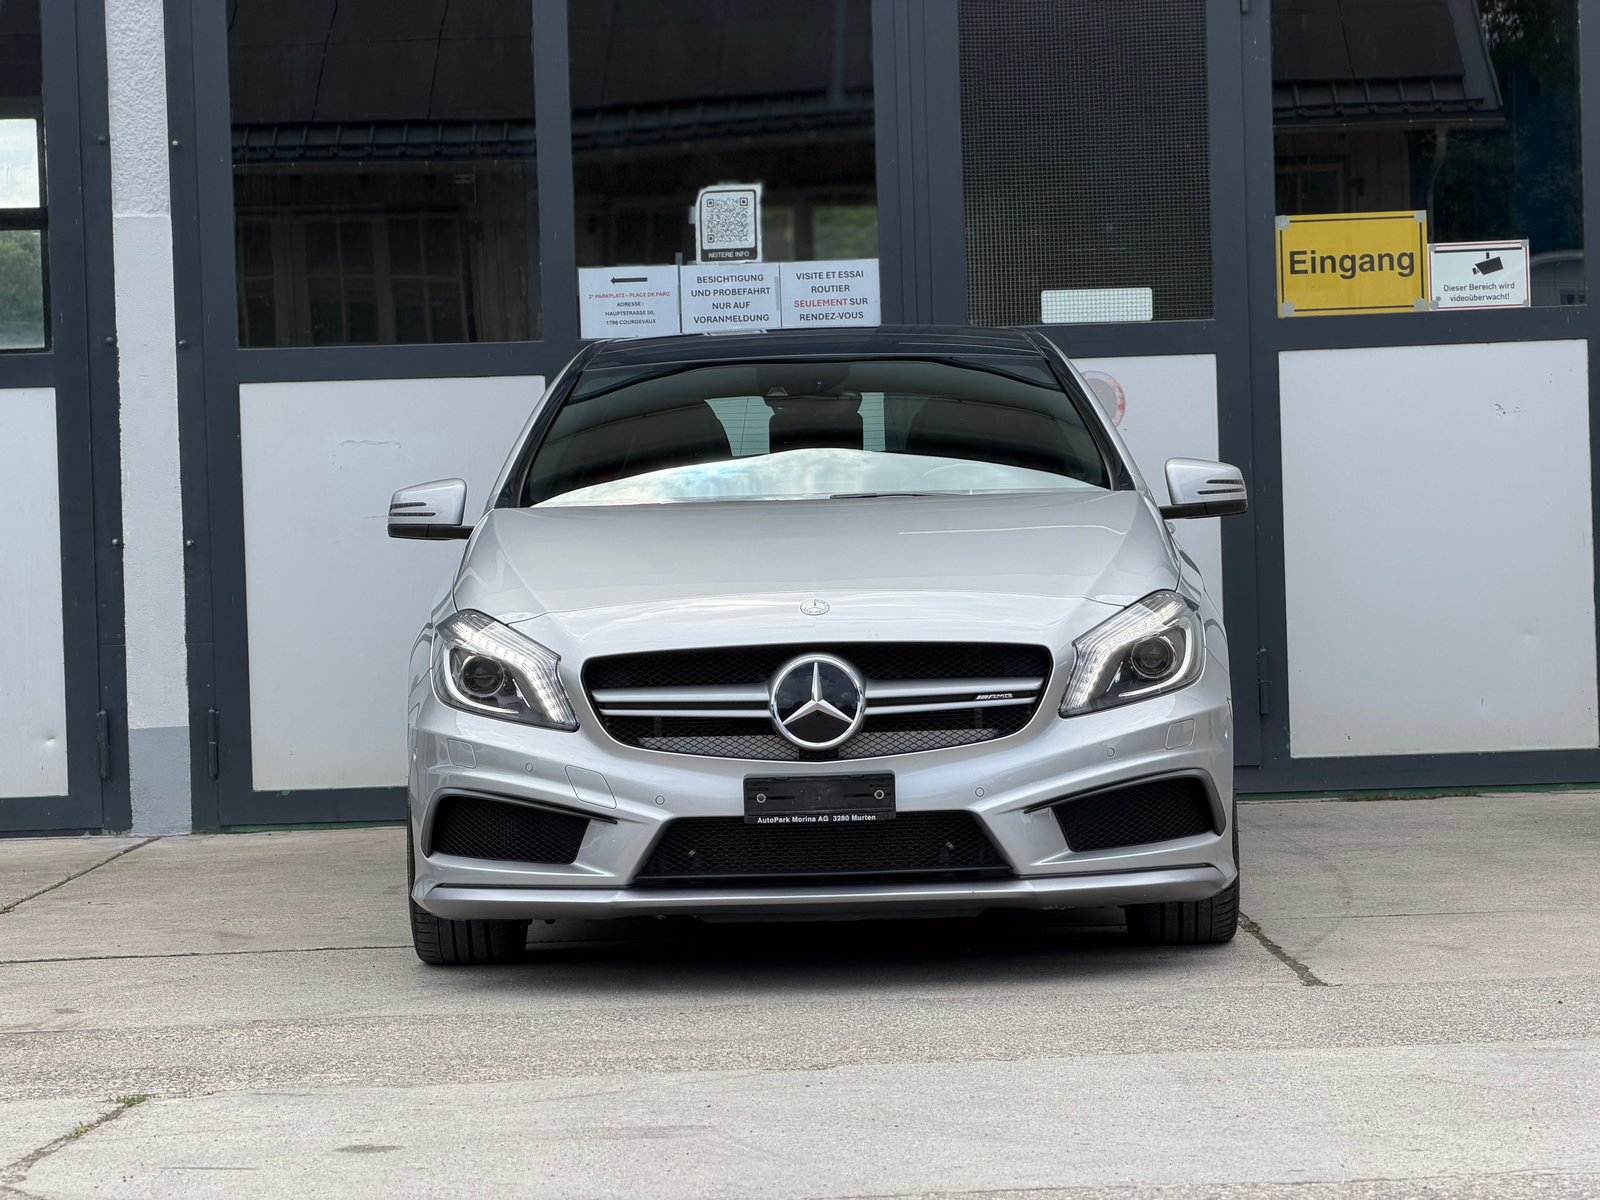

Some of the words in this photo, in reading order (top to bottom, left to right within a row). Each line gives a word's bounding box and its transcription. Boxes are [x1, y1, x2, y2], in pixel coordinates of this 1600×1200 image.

[1289, 250, 1415, 279] Eingang
[696, 274, 764, 284] BESICHTIGUNG
[796, 272, 824, 280] VISITE
[825, 271, 836, 279] ET
[838, 270, 864, 279] ESSAI
[691, 289, 711, 297] UND
[713, 287, 771, 297] PROBEFAHRT
[811, 284, 850, 293] ROUTIER
[1443, 284, 1468, 292] Dieser
[1469, 282, 1497, 291] Bereich
[1450, 293, 1510, 302] videoüberwacht!
[712, 302, 732, 310] NUR
[733, 301, 751, 309] AUF
[794, 298, 848, 308] SEULEMENT
[694, 314, 770, 324] VORANMELDUNG
[800, 311, 864, 321] RENDEZ-VOUS
[757, 816, 790, 824] AutoPark
